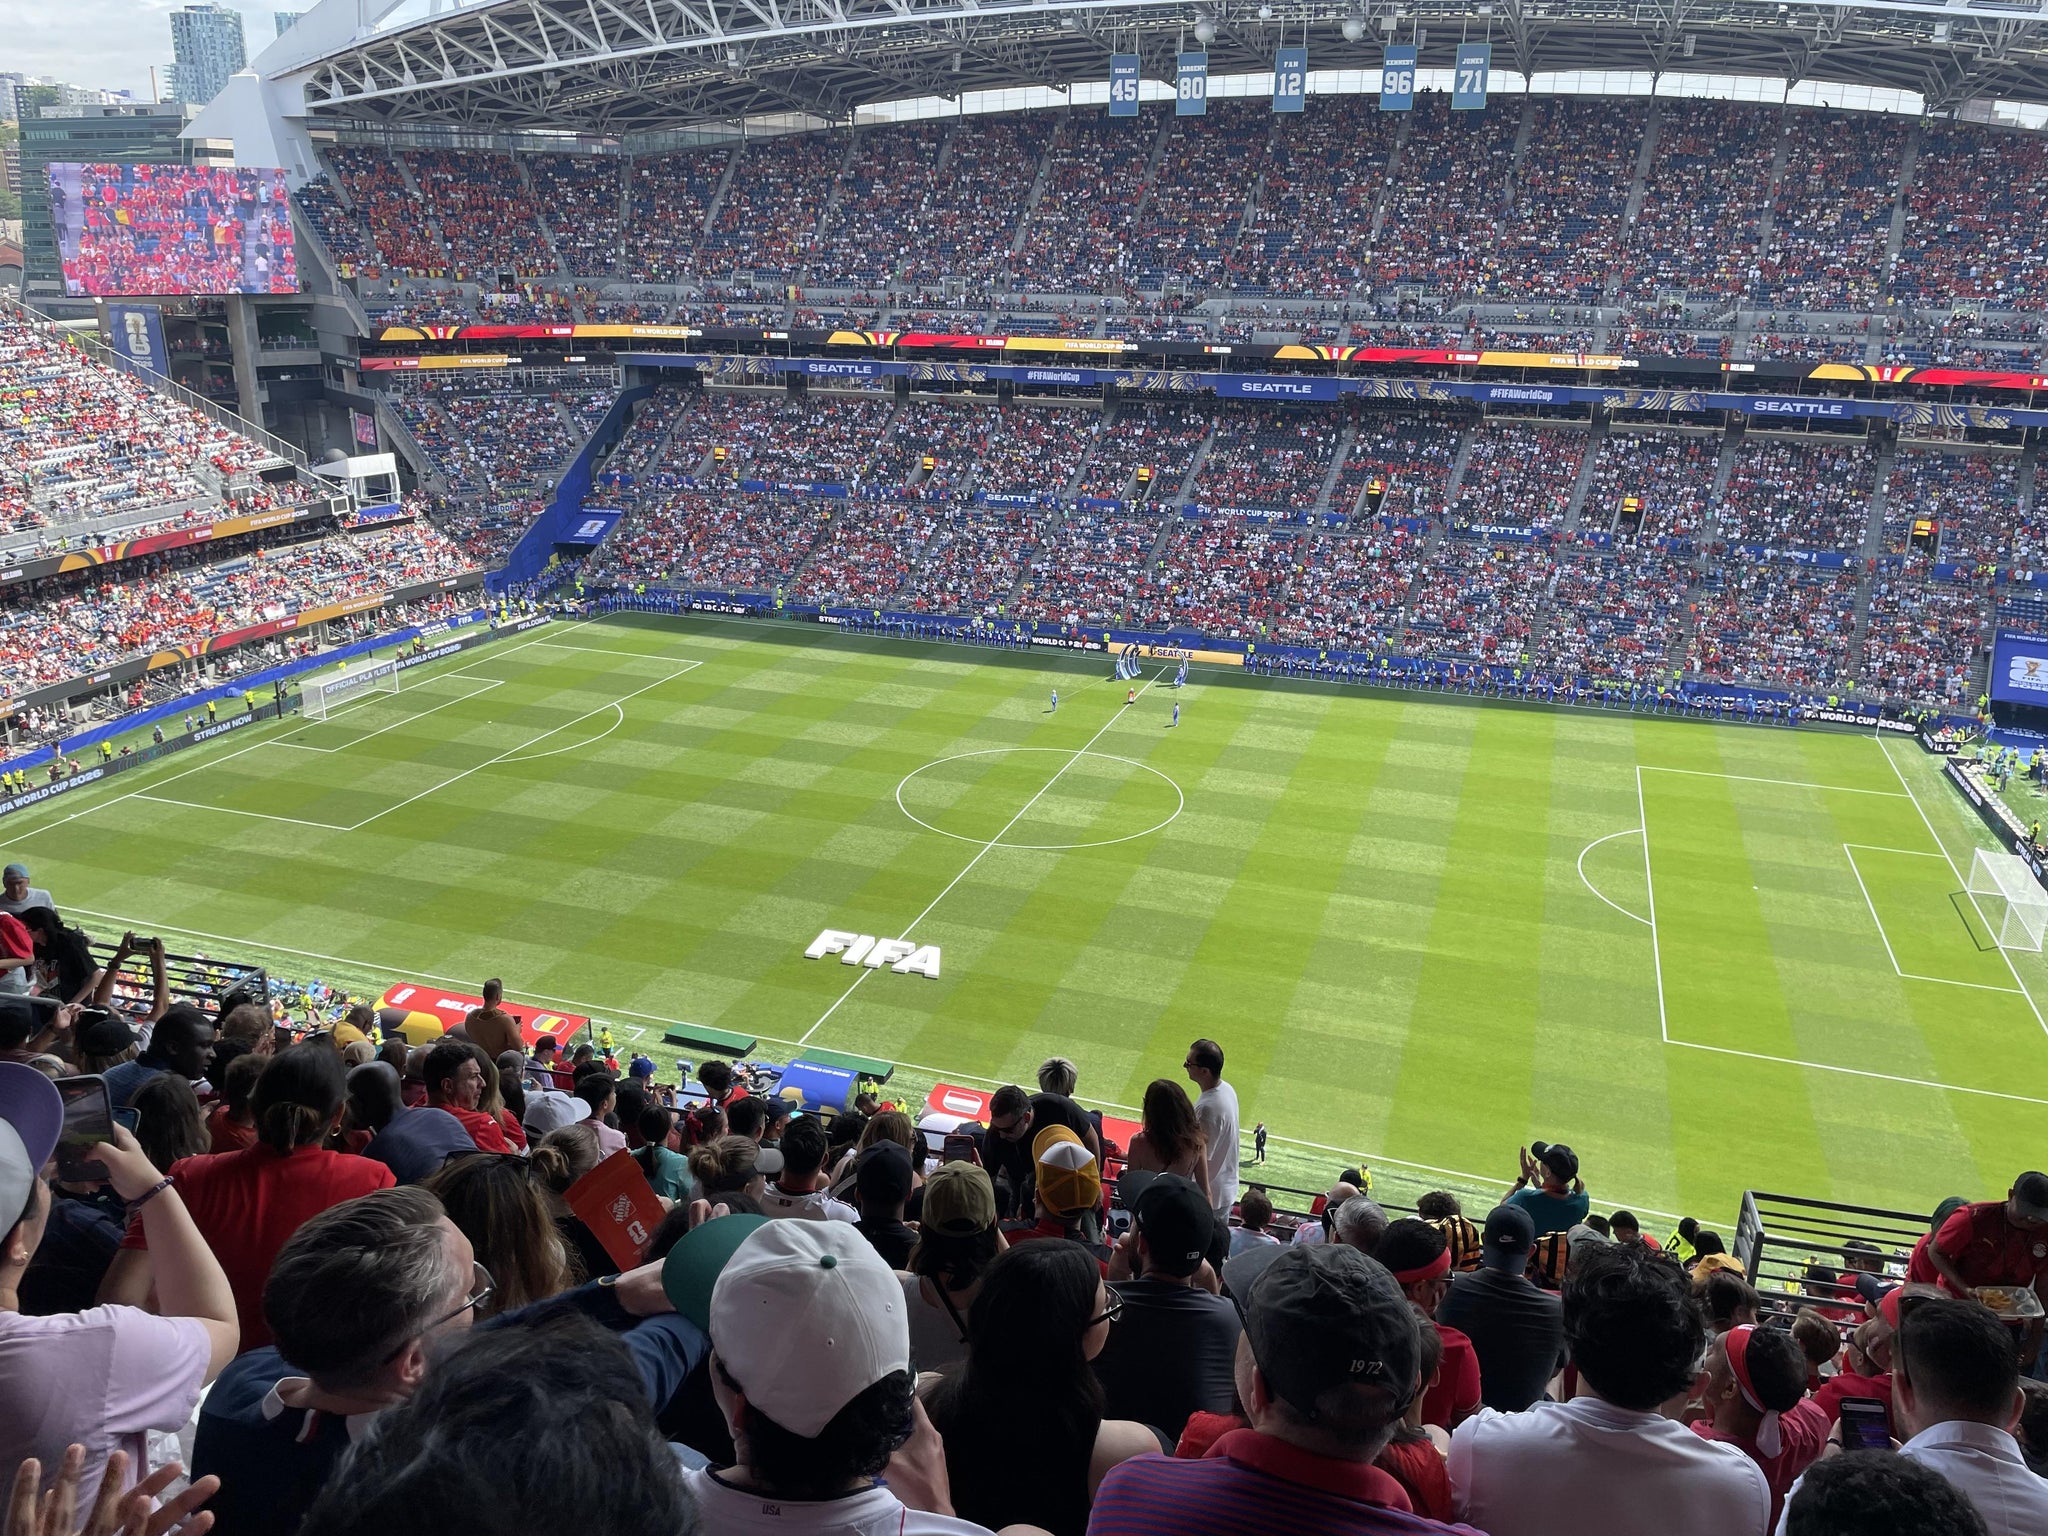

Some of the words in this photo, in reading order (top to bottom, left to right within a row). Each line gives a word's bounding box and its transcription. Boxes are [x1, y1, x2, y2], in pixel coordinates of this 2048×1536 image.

[1179, 77, 1204, 99] 80
[1278, 73, 1301, 96] 12
[1384, 71, 1412, 94] 96
[1459, 70, 1483, 93] 71
[1111, 79, 1136, 101] 45
[808, 363, 872, 374] SEATTLE
[1027, 371, 1080, 383] #FIFAWorldCup
[1241, 382, 1312, 394] SEATTLE
[1490, 389, 1553, 401] #FIFAWorldCup
[1754, 400, 1843, 415] SEATTLE
[986, 493, 1037, 503] SEATTLE
[262, 514, 280, 524] WORLD
[281, 512, 290, 520] CUP
[1218, 507, 1246, 516] WORLD
[1247, 509, 1262, 517] CUP
[1471, 524, 1532, 536] SEATTLE
[457, 615, 473, 625] FIFA
[1032, 637, 1057, 645] WORLD
[325, 674, 358, 694] OFFICIAL
[405, 653, 428, 667] WORLD
[427, 649, 440, 659] CUP
[1820, 711, 1856, 723] WORLD
[1856, 715, 1877, 726] CUP
[194, 722, 230, 741] STREAM
[232, 714, 252, 728] NOW
[14, 789, 49, 808] WORLD
[50, 781, 68, 794] CUP
[804, 929, 941, 979] FIFA
[1349, 1360, 1383, 1375] 1972
[762, 1503, 780, 1516] USA
